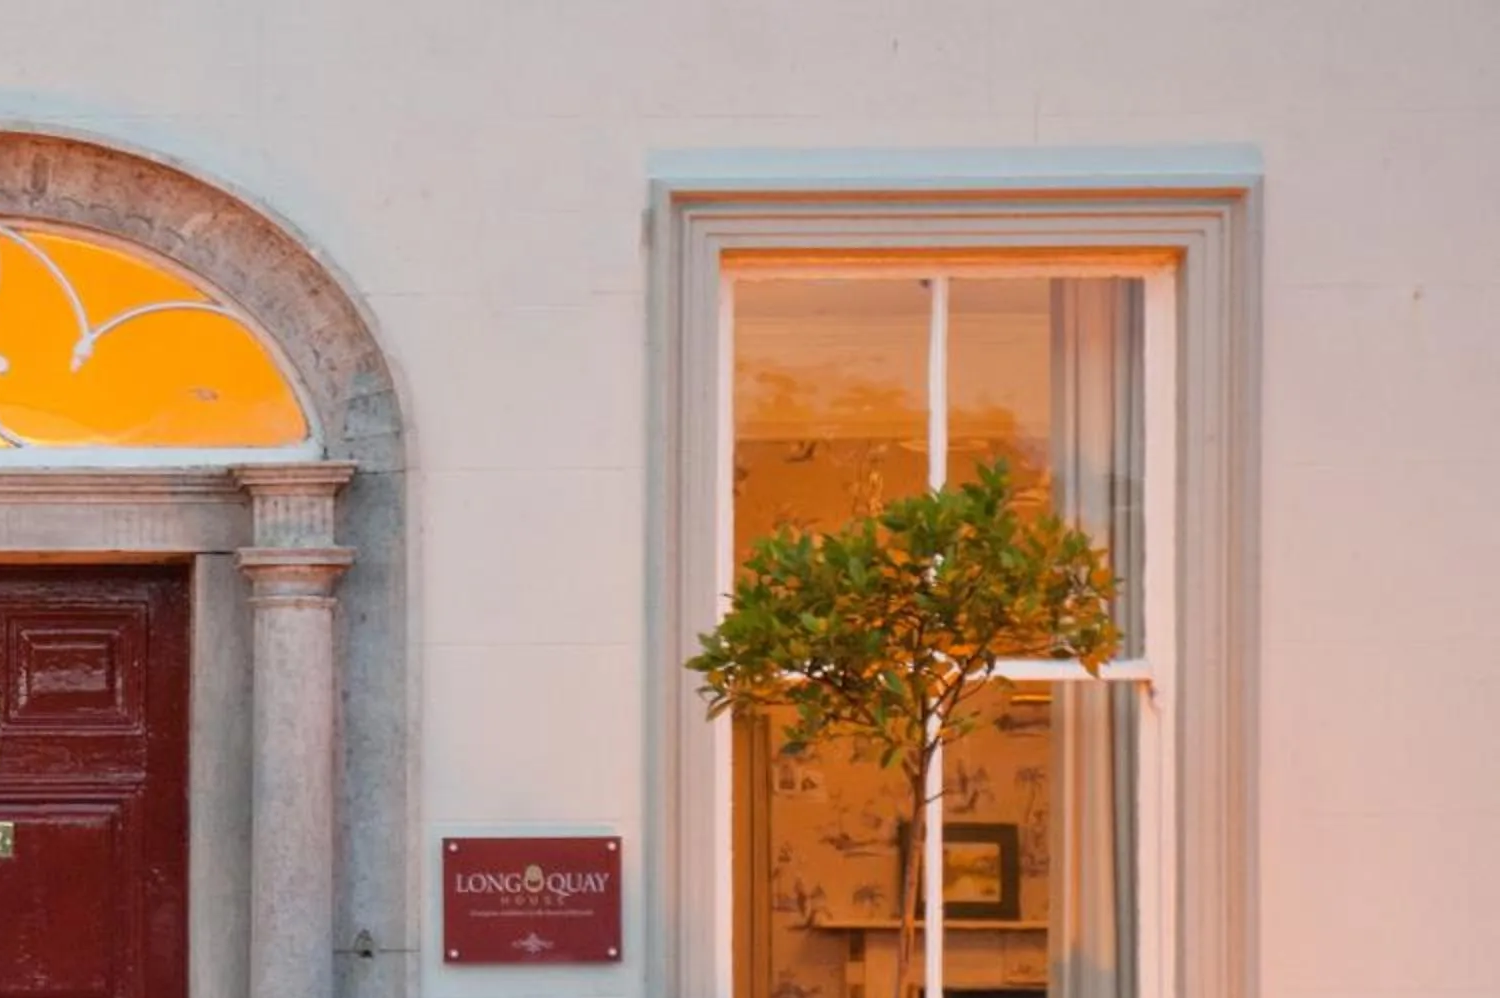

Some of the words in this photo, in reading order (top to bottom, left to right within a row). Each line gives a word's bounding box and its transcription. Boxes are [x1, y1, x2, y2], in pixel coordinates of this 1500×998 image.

[456, 873, 521, 893] LONG
[546, 873, 609, 897] QUAY
[499, 895, 566, 906] HOUSE
